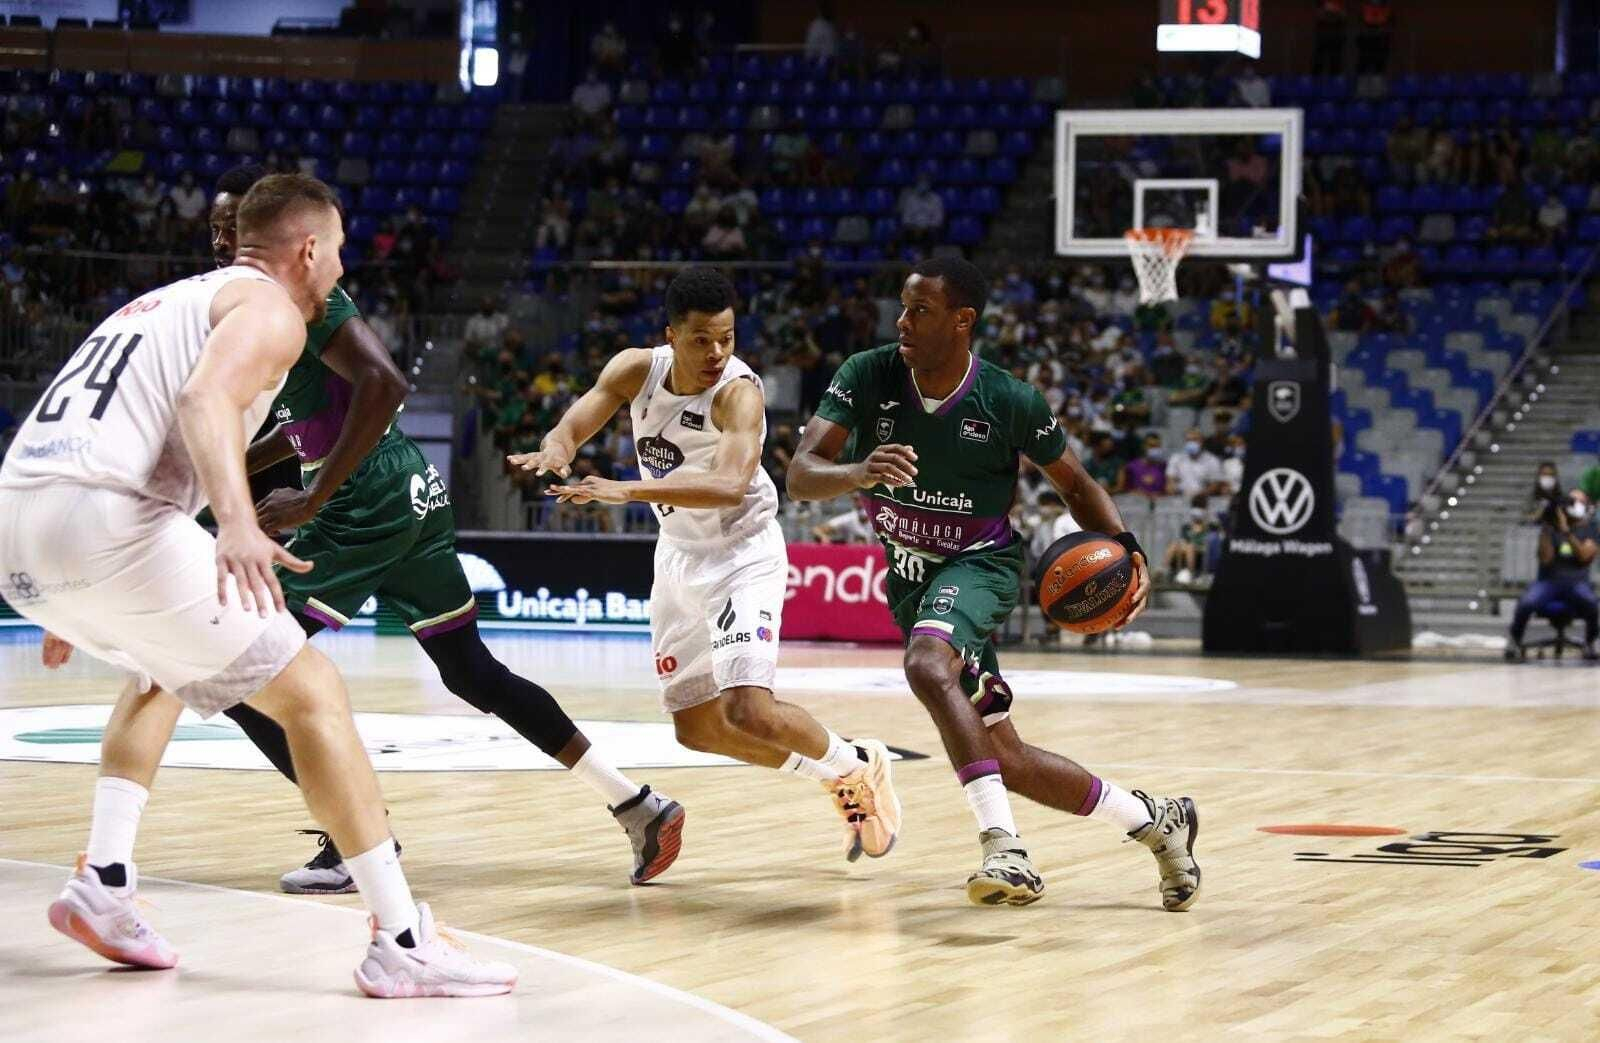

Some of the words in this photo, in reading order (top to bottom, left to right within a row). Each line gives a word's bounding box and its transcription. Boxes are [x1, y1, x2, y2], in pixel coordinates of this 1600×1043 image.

[36, 333, 143, 422] 24
[912, 488, 973, 511] Unicaja
[899, 518, 962, 539] MÁLAGA
[497, 586, 603, 624] Unicaja
[711, 632, 751, 650] ANDELAS
